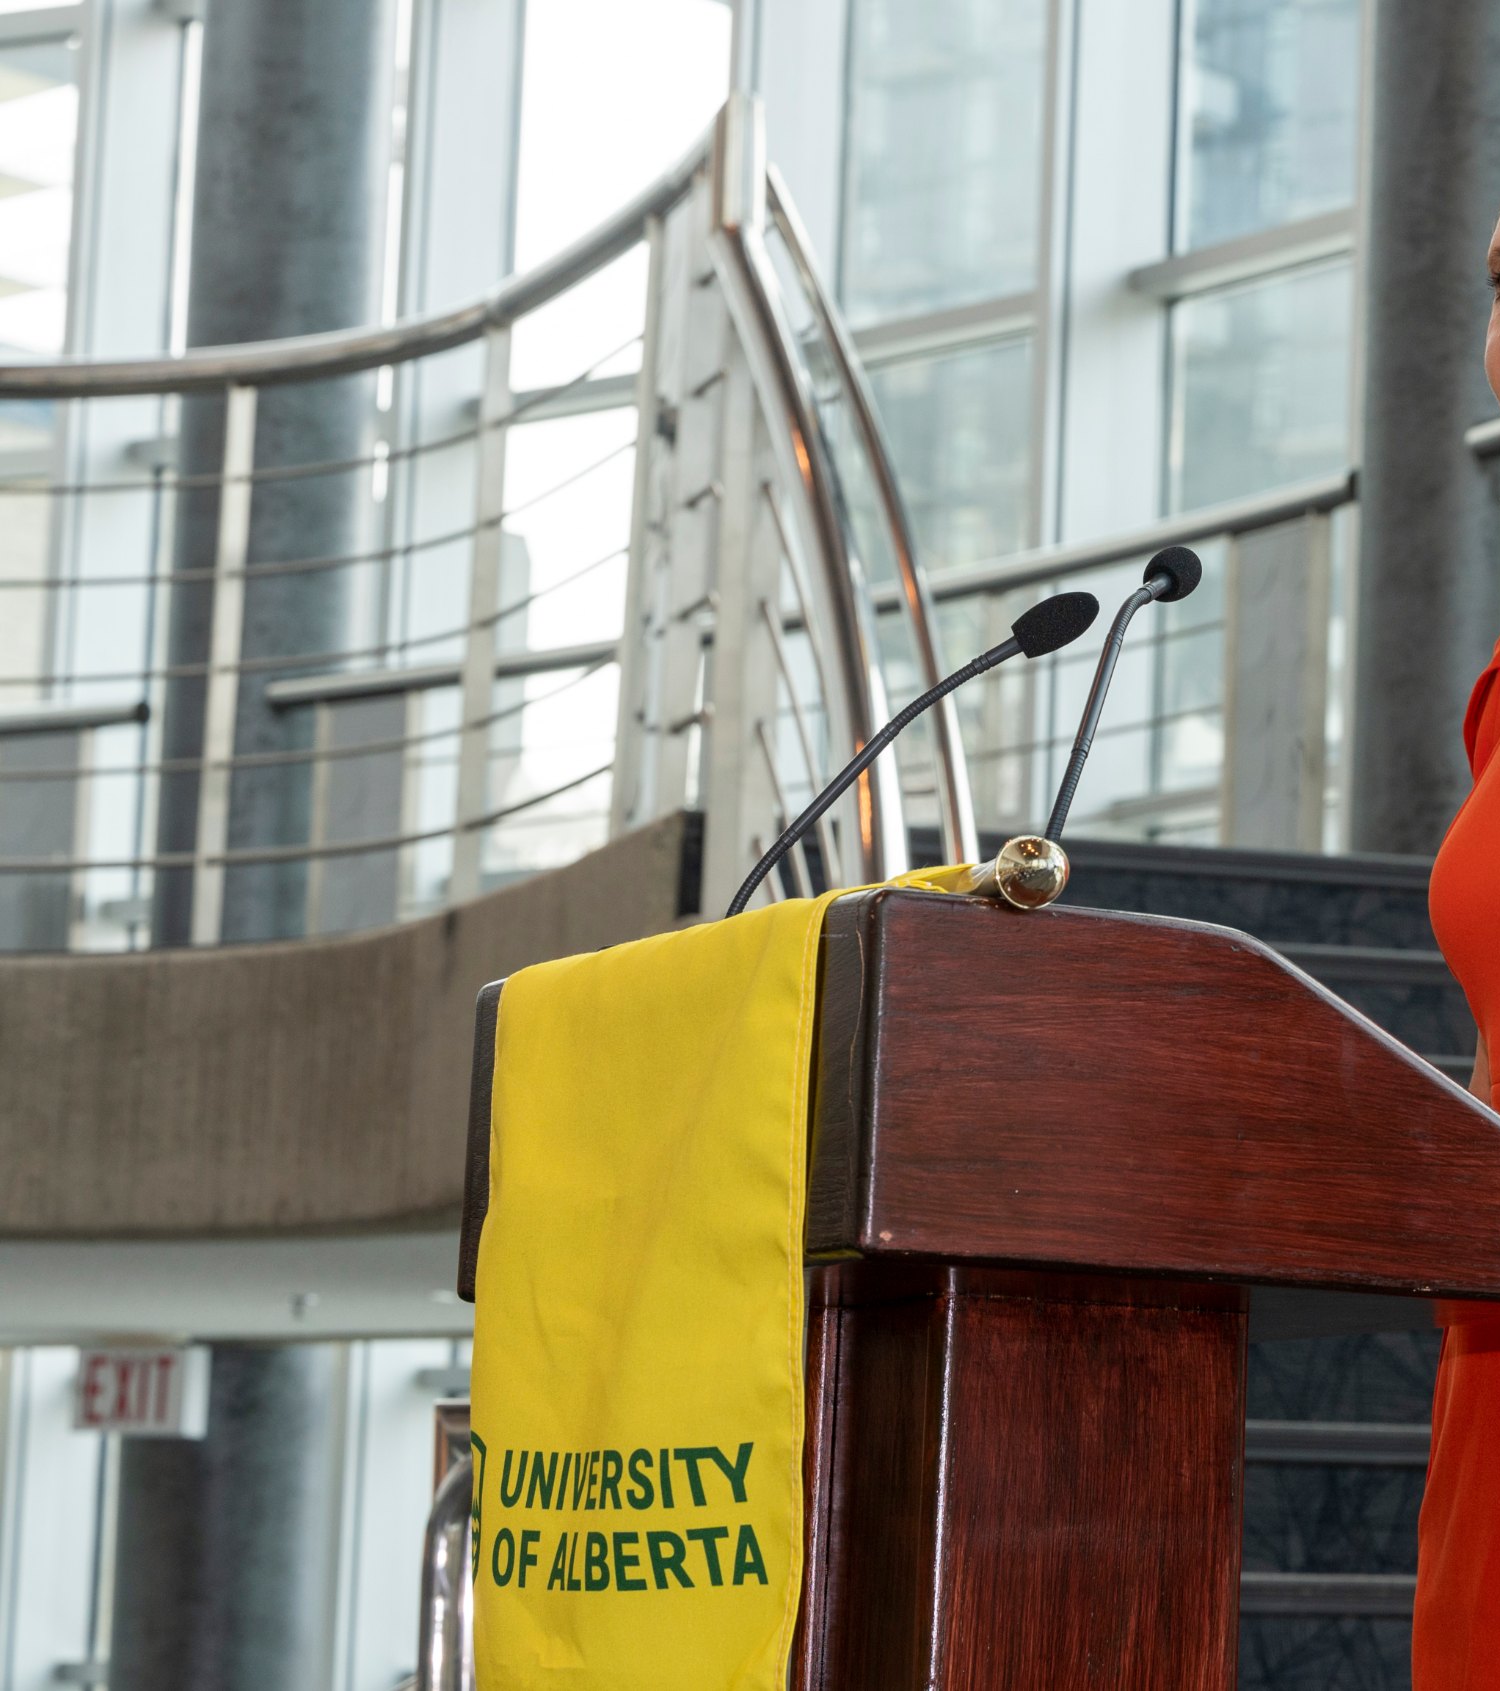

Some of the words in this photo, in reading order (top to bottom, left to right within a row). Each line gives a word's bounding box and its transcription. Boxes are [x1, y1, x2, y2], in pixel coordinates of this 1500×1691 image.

[83, 1355, 174, 1423] EXIT
[499, 1442, 754, 1511] UNIVERSITY
[491, 1527, 541, 1588] OF
[547, 1524, 769, 1591] ALBERTA
